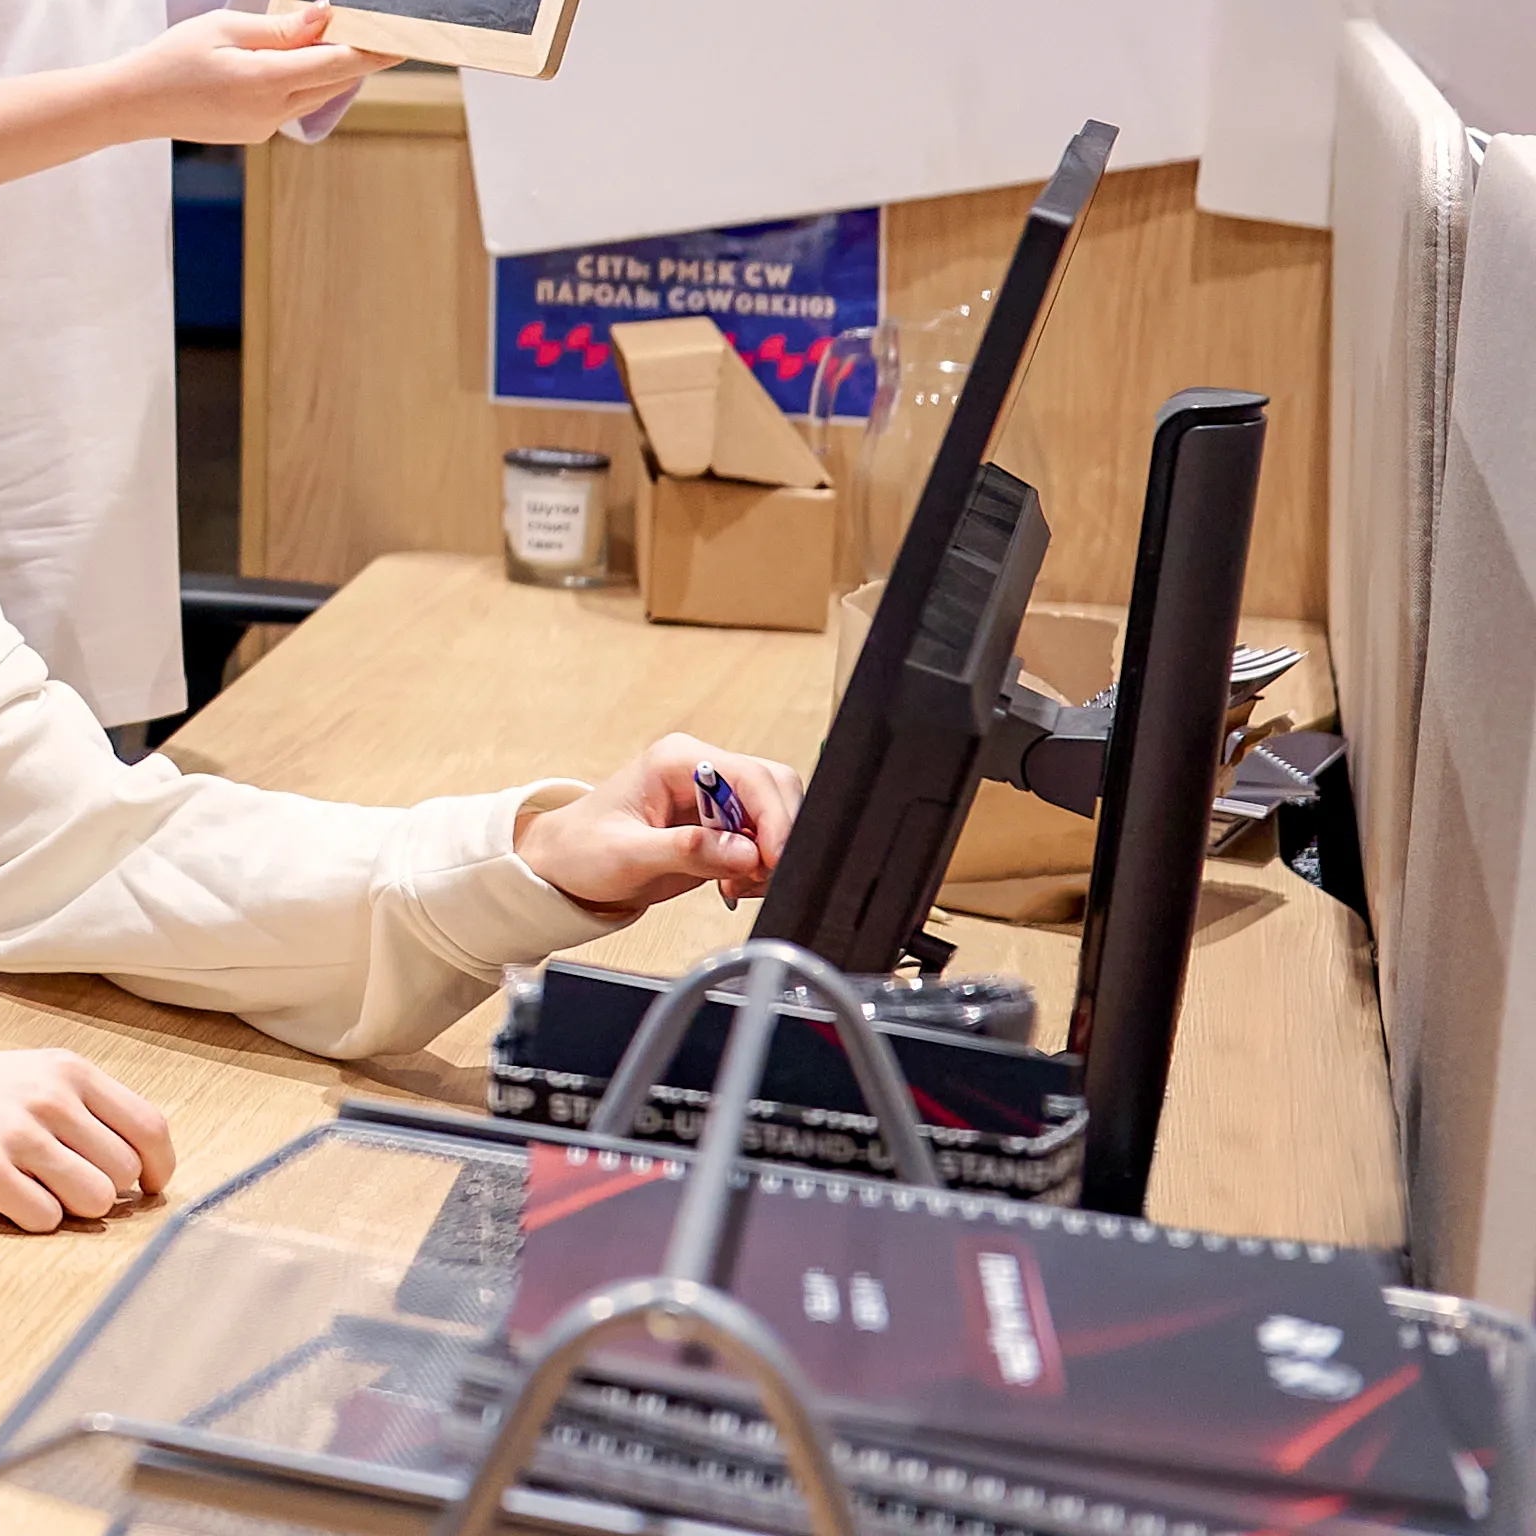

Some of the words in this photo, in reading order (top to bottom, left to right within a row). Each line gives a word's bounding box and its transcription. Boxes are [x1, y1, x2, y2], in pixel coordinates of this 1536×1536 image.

[577, 254, 650, 281] СЕТЬ:
[658, 258, 737, 286] PMSK
[743, 263, 794, 289] CW
[535, 278, 660, 309] ПАРОЛЬ:
